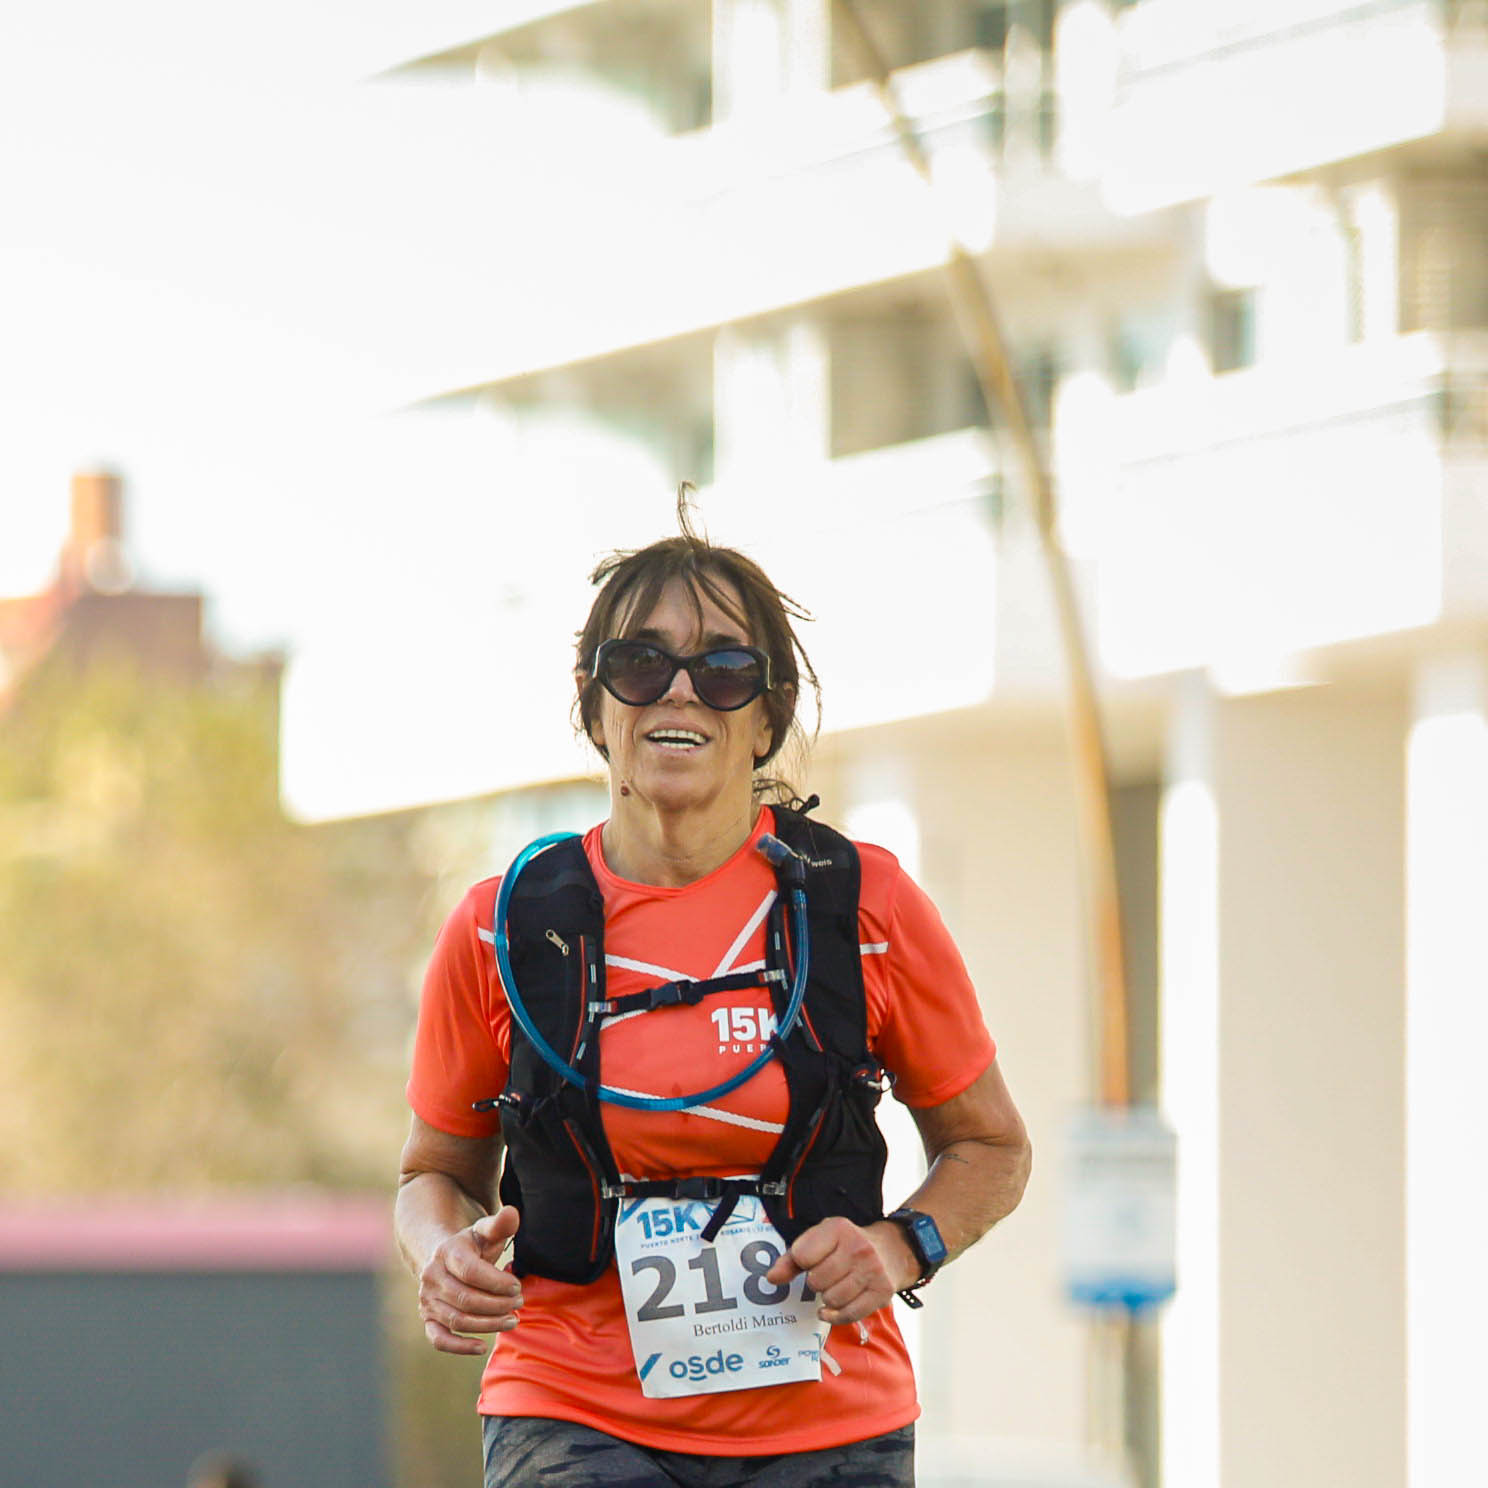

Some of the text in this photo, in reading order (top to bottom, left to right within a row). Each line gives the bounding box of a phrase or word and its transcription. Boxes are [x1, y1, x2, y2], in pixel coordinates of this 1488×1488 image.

[711, 1007, 778, 1041] 15K
[637, 1203, 701, 1239] 15K
[693, 1312, 798, 1337] Bertoldi Marisa
[669, 1350, 744, 1380] osde
